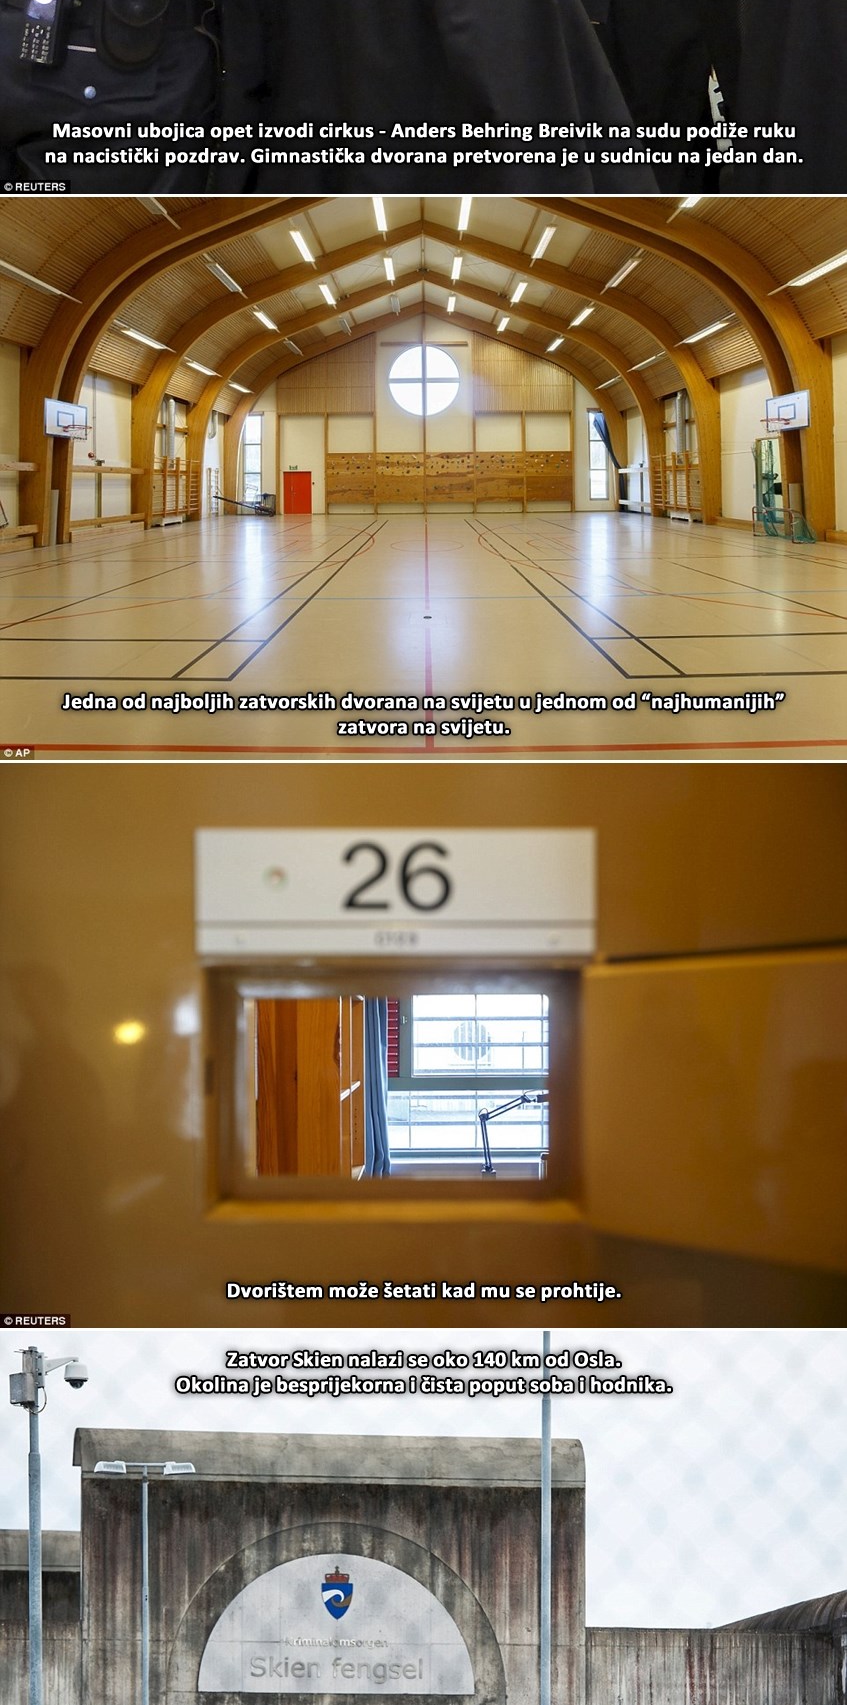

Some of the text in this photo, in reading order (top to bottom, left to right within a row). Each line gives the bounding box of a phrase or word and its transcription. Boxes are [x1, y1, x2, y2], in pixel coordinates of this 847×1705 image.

[342, 840, 453, 914] 26
[250, 1656, 424, 1685] Skien fengsel
